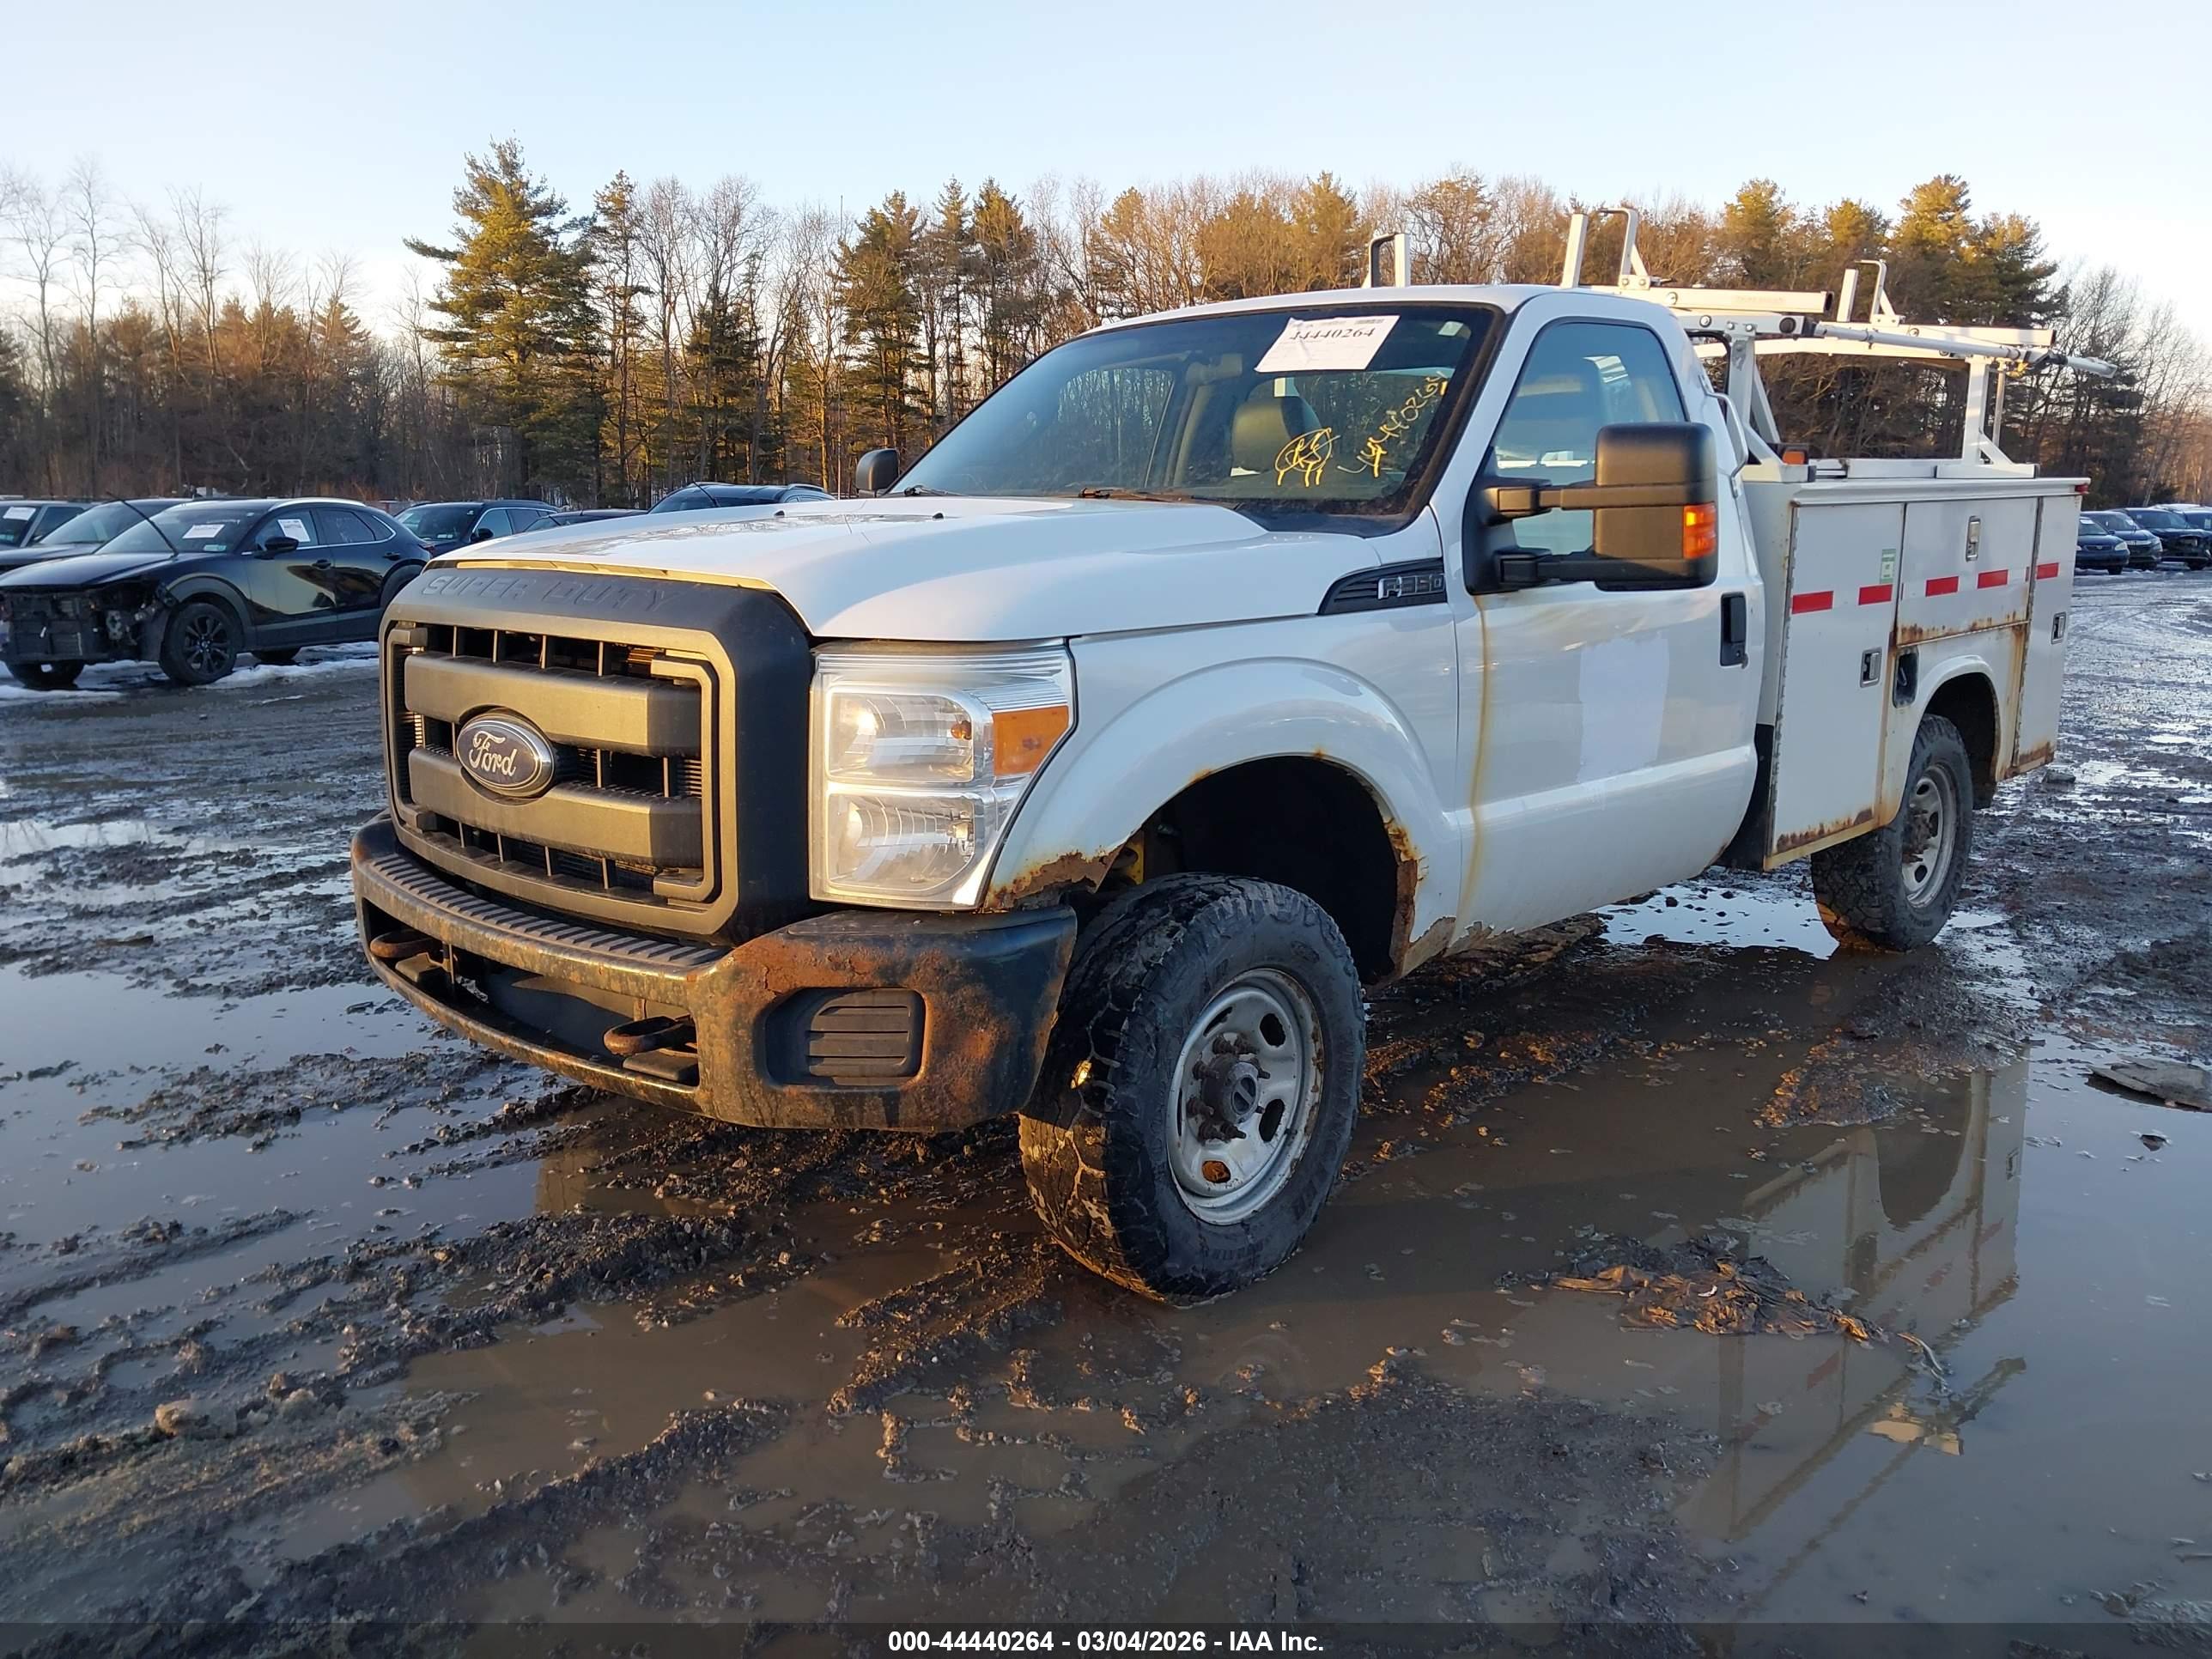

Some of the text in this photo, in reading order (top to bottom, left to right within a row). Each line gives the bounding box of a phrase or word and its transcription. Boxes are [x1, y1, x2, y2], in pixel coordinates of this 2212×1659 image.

[1289, 326, 1376, 341] 44440264
[421, 574, 684, 612] SUPER DUTY
[468, 730, 519, 777] Ford
